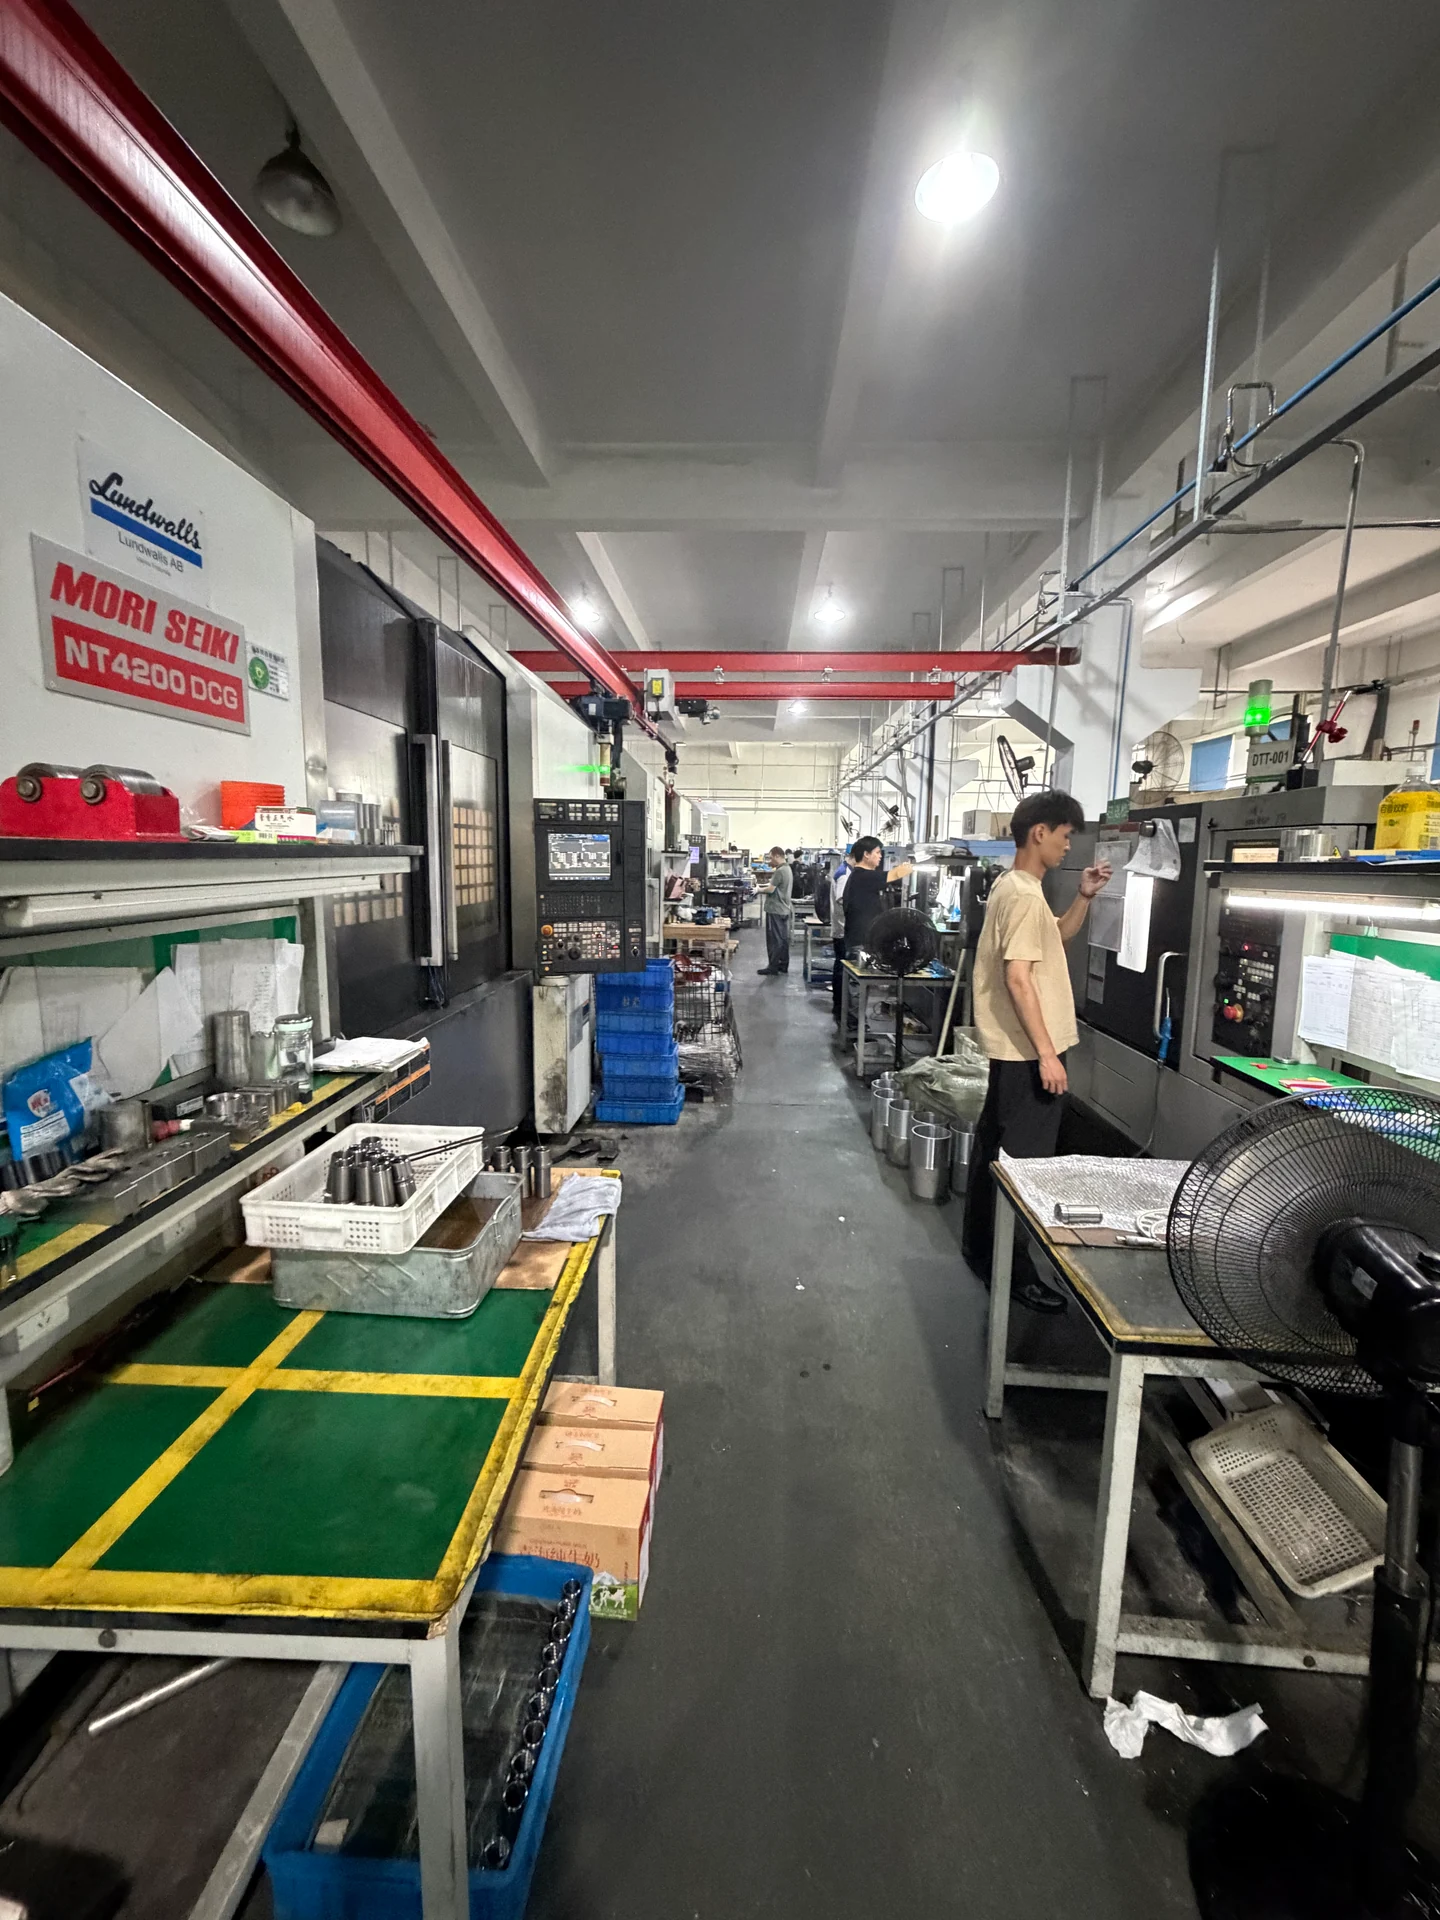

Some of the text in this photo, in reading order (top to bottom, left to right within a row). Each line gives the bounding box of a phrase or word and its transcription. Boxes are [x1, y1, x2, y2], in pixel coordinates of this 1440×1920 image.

[118, 531, 168, 566] Lundwalls
[170, 558, 184, 573] AB
[50, 561, 240, 665] MORI SEIKI
[64, 634, 186, 696] NT4200
[191, 678, 238, 710] DCG
[1252, 750, 1289, 767] DTT-001
